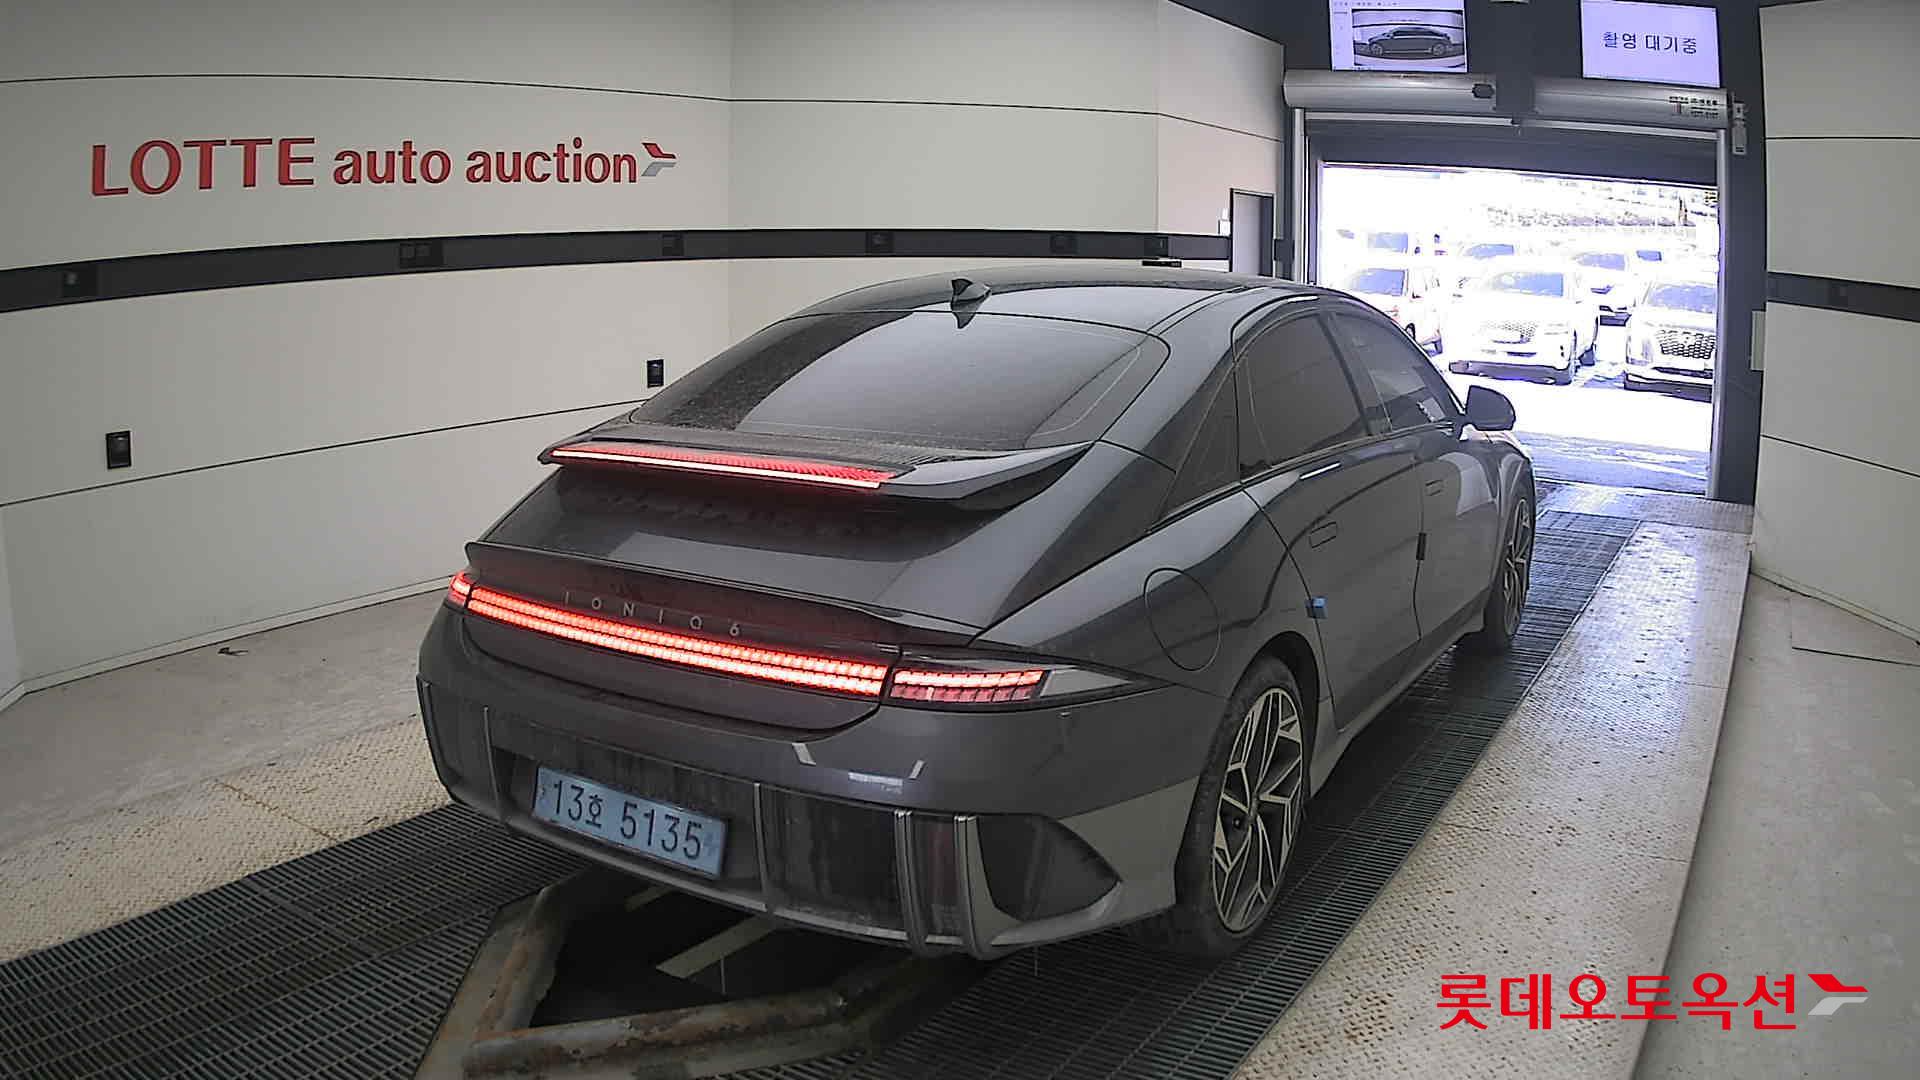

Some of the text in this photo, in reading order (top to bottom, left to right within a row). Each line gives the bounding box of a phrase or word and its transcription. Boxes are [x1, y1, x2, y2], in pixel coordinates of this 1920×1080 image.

[1645, 34, 1697, 54] 대기중
[91, 136, 638, 196] LOTTE auto auction
[564, 591, 740, 637] IONIQ 6
[553, 779, 702, 860] 13호 5135
